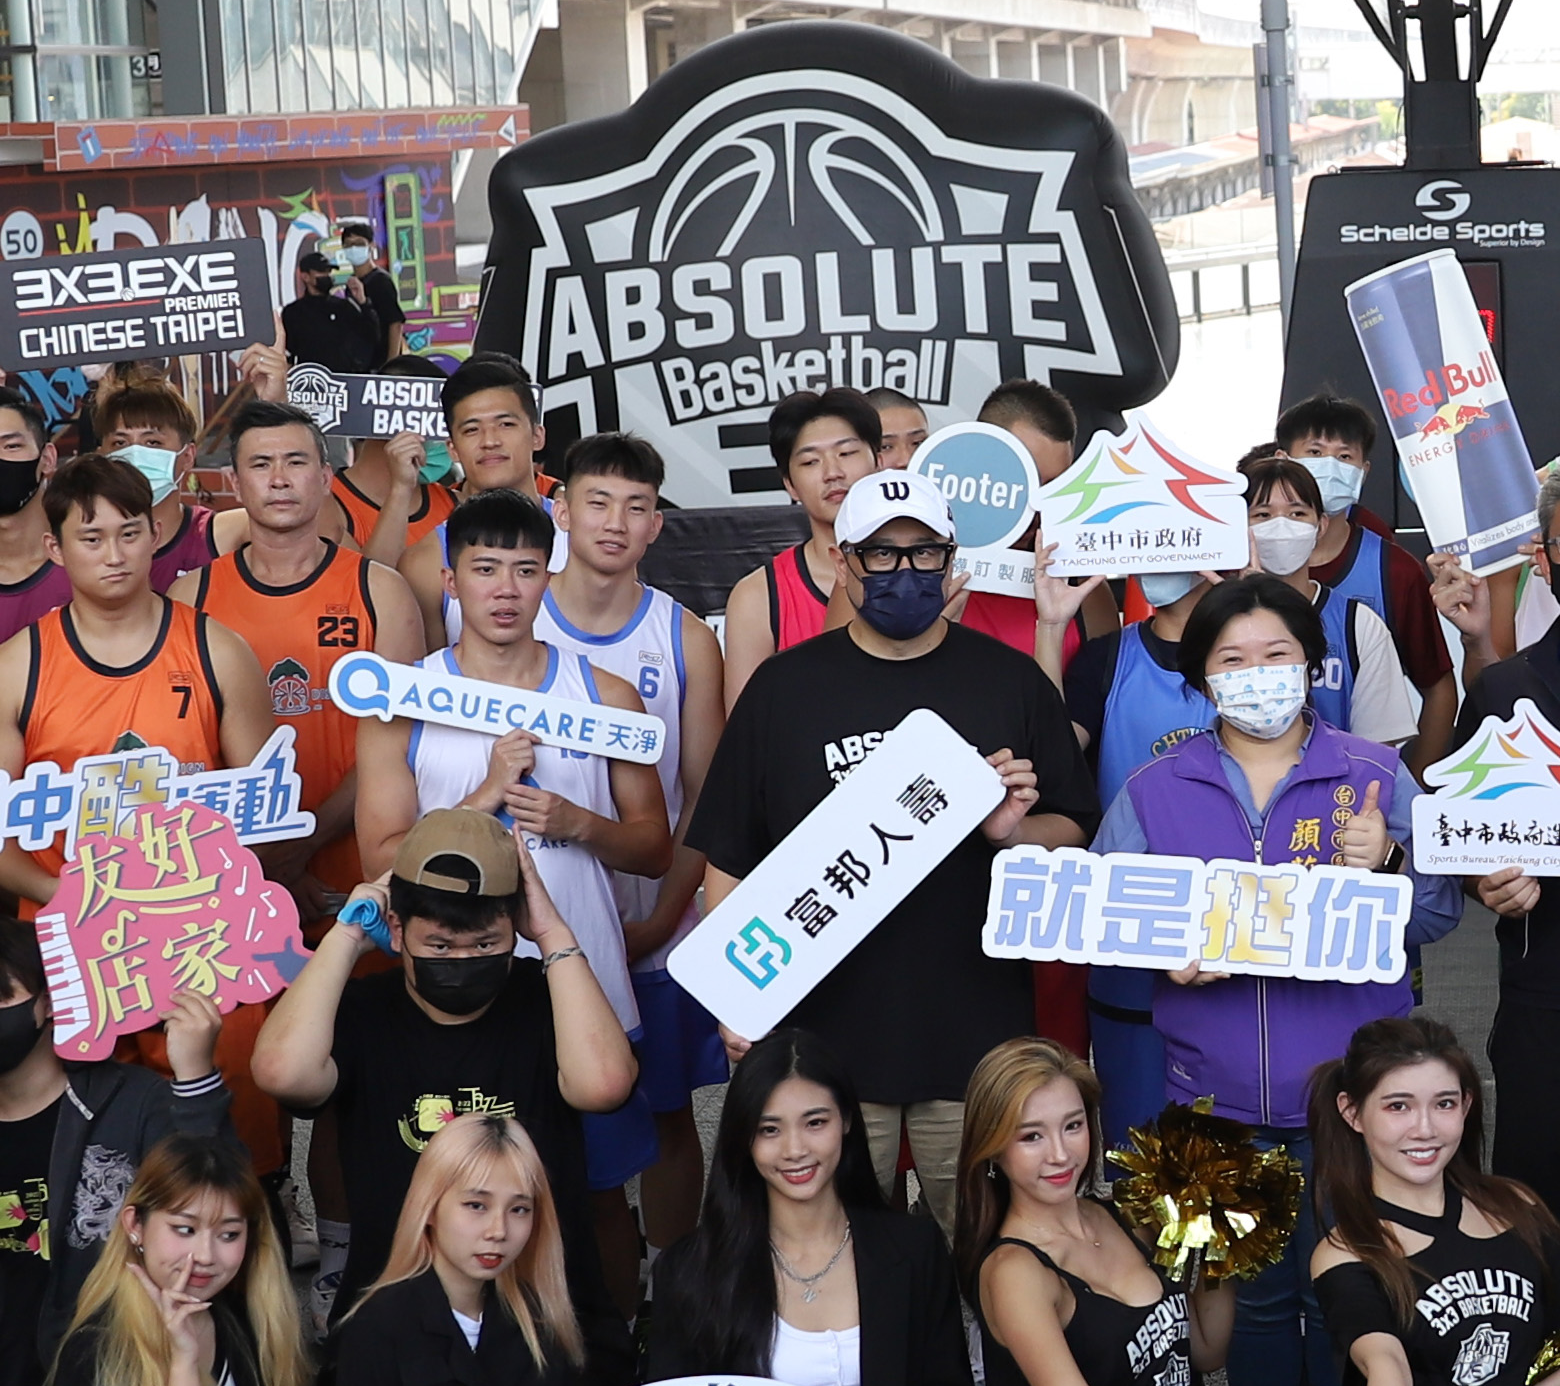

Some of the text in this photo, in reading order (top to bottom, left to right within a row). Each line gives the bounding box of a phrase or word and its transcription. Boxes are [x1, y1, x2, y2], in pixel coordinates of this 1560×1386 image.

[5, 228, 38, 255] 50
[1340, 220, 1546, 246] Schelde Sports
[1479, 237, 1546, 249] Superior by Design
[163, 291, 241, 313] PREMIER
[546, 244, 1068, 380] ABSOLUTE
[19, 307, 245, 359] CHINESE TAIPEI
[661, 334, 950, 419] Basketball
[1383, 351, 1499, 419] Red Bull
[928, 461, 1025, 512] Footer
[1060, 551, 1223, 568] TAICHUNG CITY GOVERNMENT
[1074, 525, 1203, 551] 臺中市政府
[317, 616, 359, 648] 23
[171, 686, 192, 719] 7
[397, 681, 659, 757] AQUECARE 天淨
[76, 806, 226, 919] 友好
[784, 773, 952, 940] 富邦人壽
[1428, 854, 1458, 867] Sports
[992, 856, 1400, 973] 就是挺你
[90, 919, 244, 1037] 店家
[1414, 1269, 1536, 1321] ABSOLUTE
[1430, 1292, 1532, 1337] 3x3 BASKETBALL
